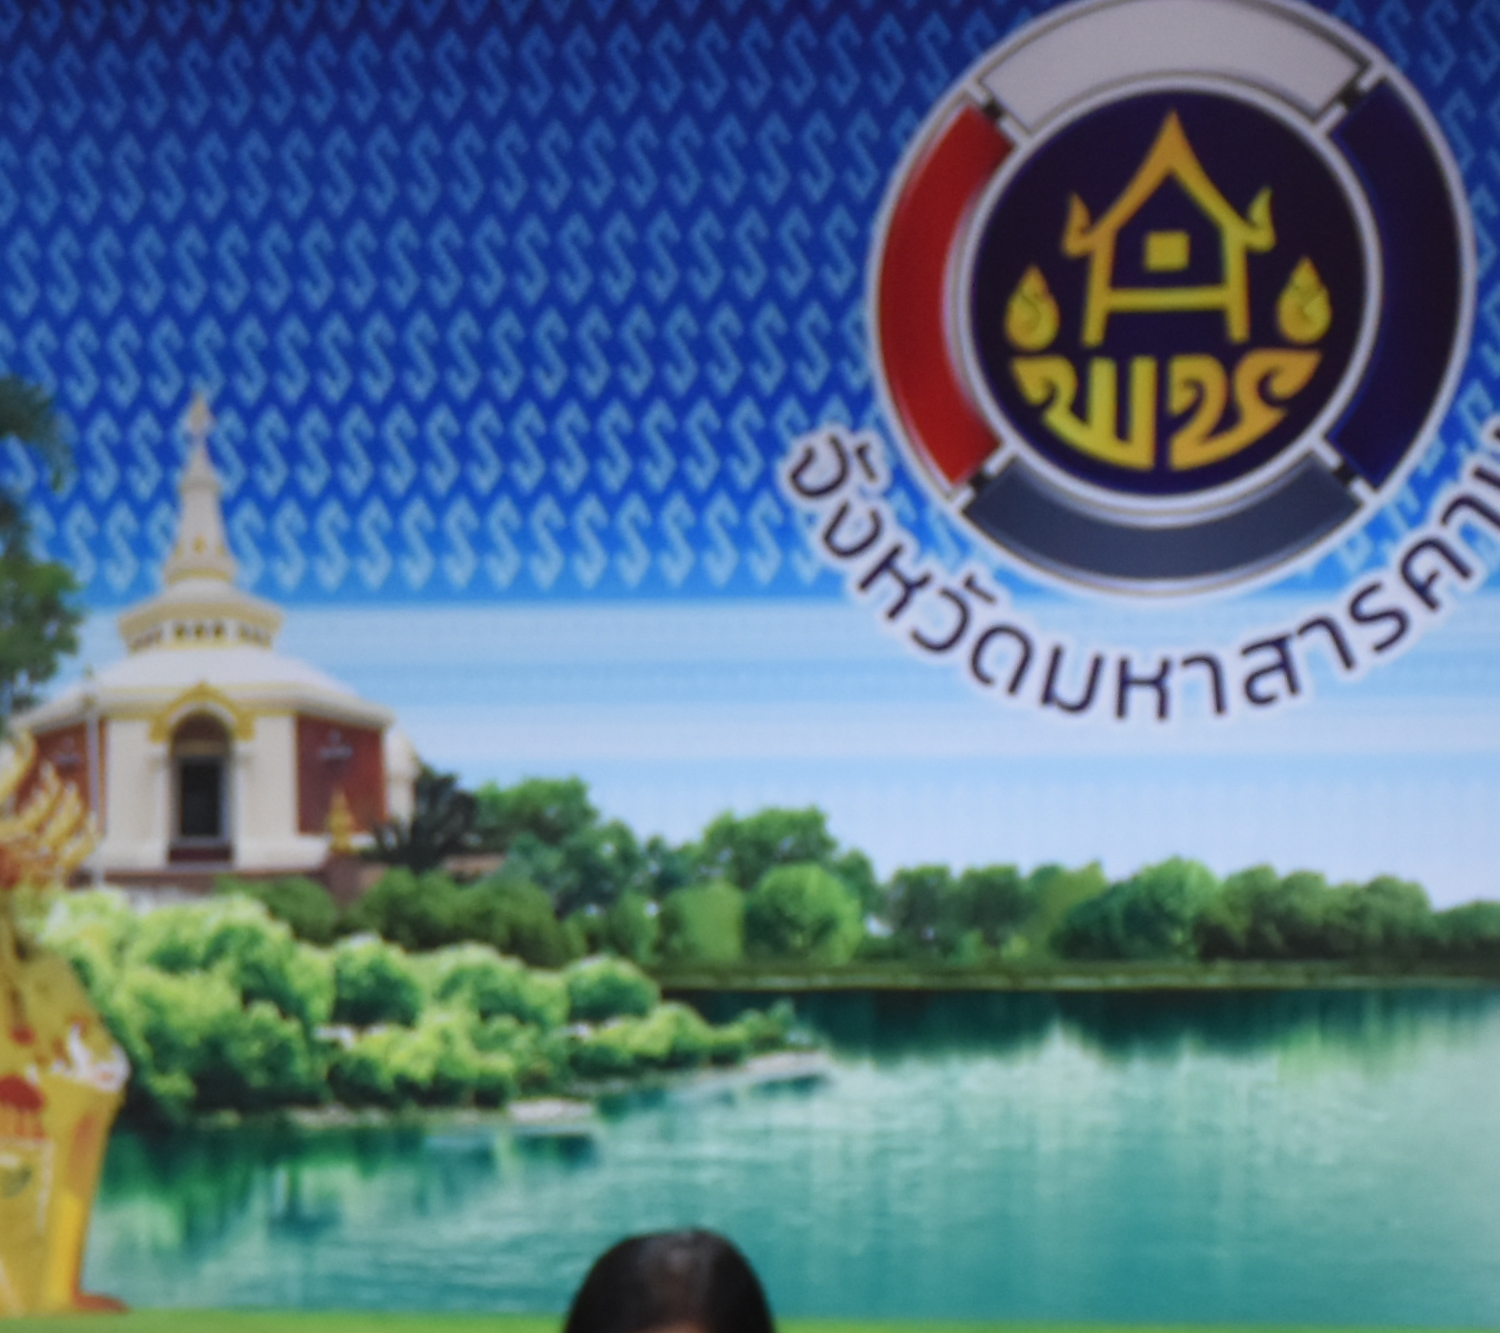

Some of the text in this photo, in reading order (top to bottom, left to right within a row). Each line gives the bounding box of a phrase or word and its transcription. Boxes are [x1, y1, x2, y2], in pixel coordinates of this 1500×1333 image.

[788, 427, 1500, 720] จังหวัดมหาสารคา
